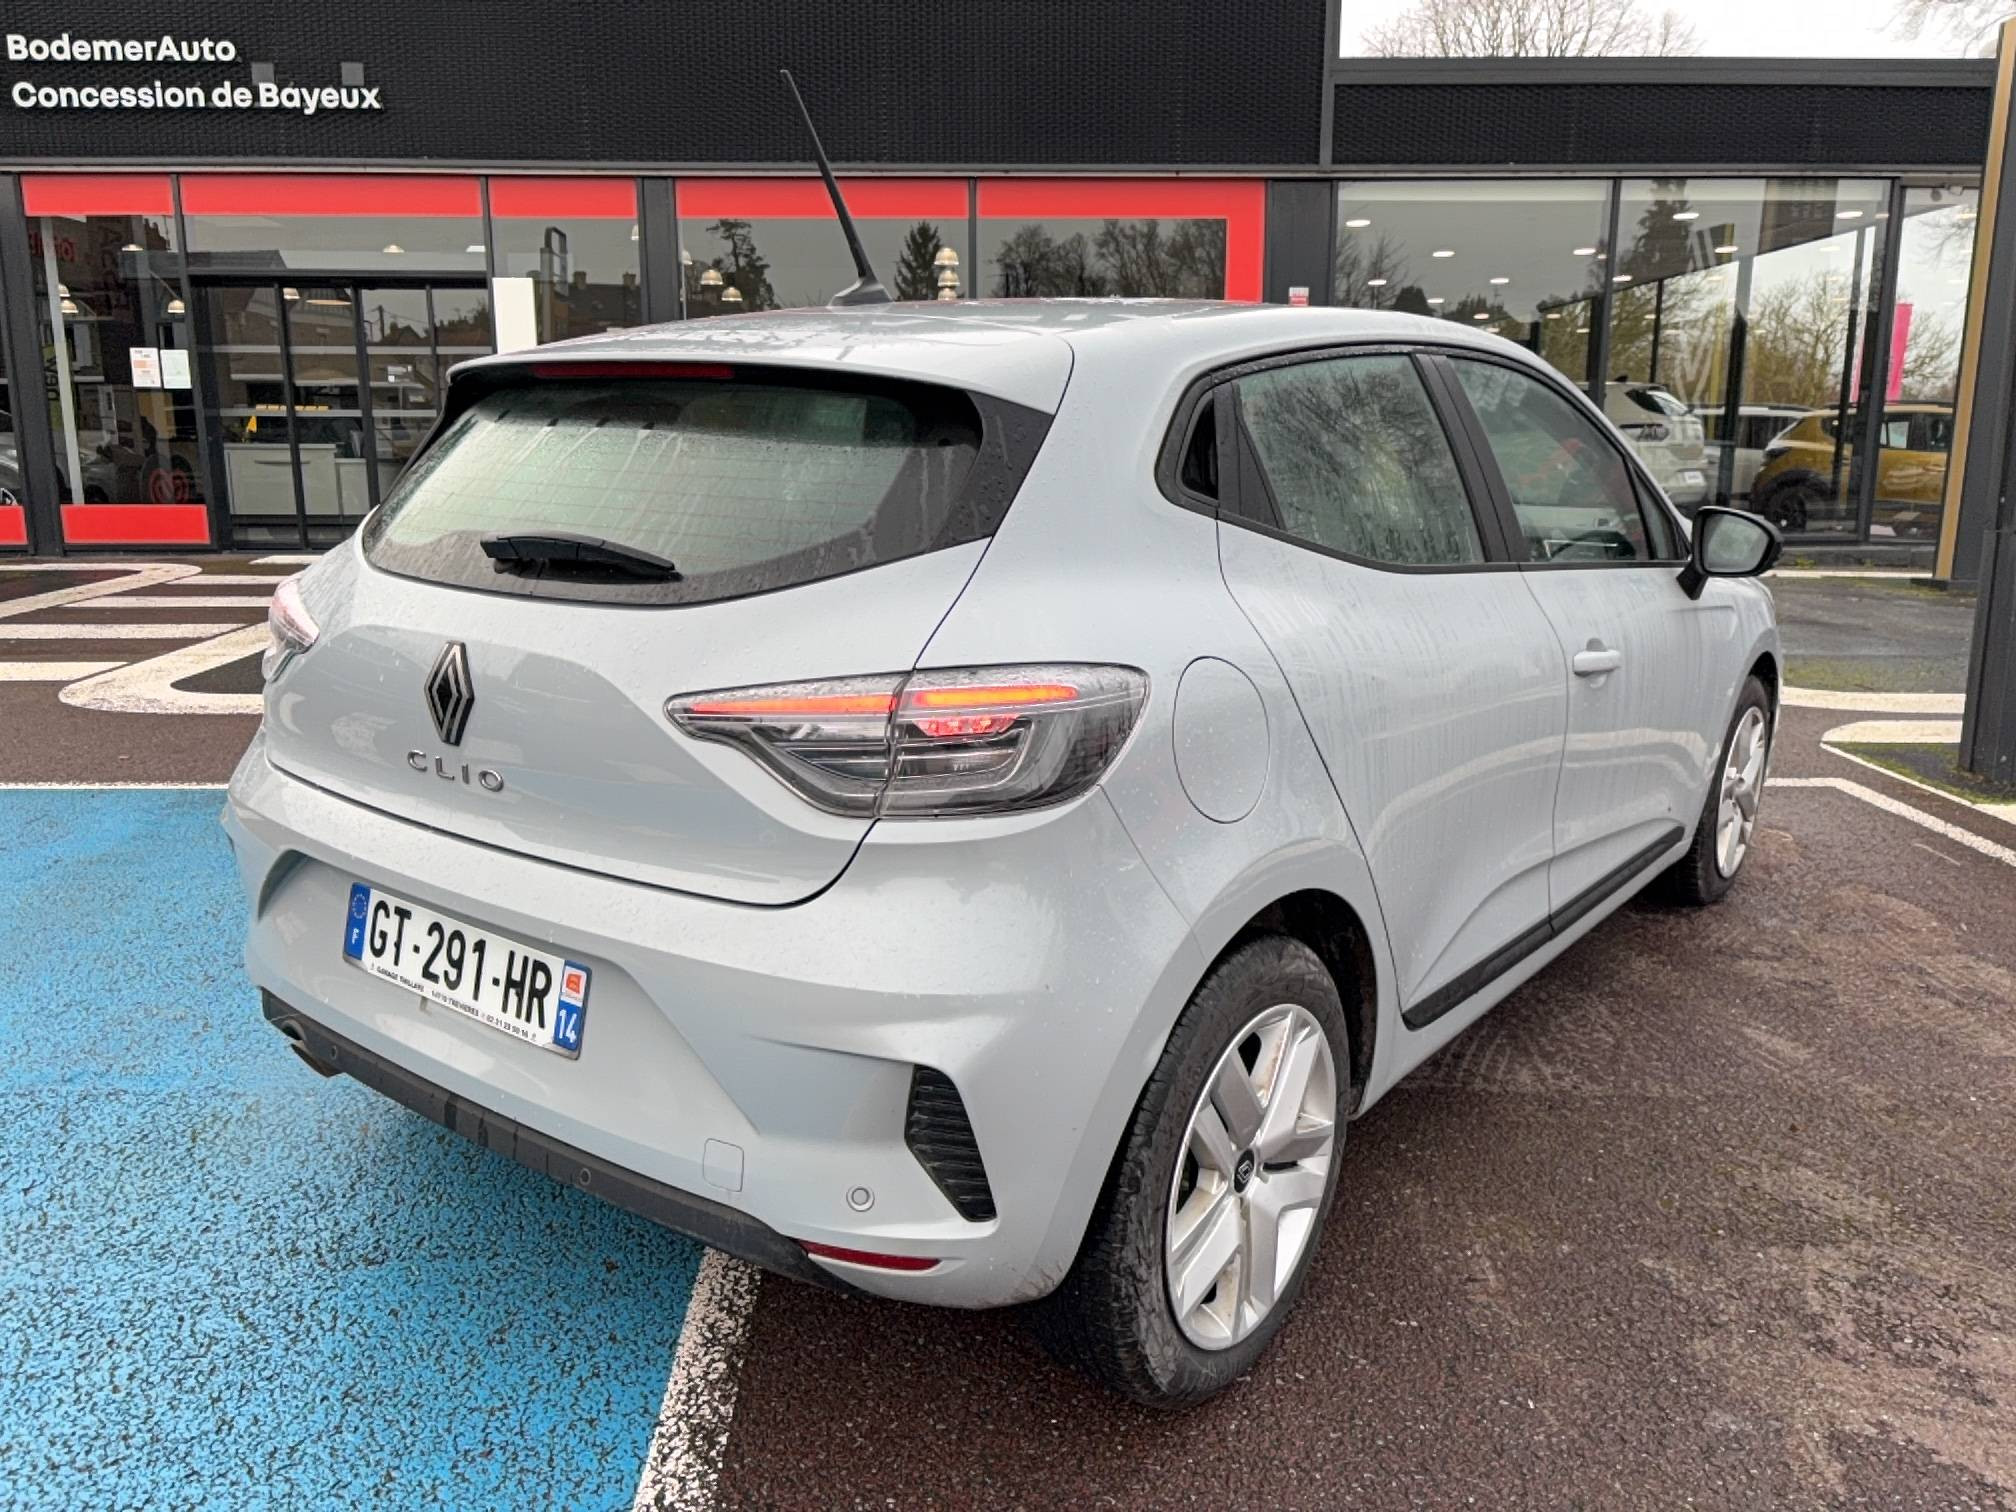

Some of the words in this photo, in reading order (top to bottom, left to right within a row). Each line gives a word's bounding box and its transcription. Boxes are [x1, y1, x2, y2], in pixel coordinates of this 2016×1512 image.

[6, 33, 236, 62] BodemerAuto
[12, 80, 206, 108] Concession
[211, 81, 252, 108] de
[258, 82, 381, 115] Bayeux
[407, 750, 504, 793] CLIO
[369, 900, 552, 1029] GT-291-HR
[558, 1009, 577, 1043] 14
